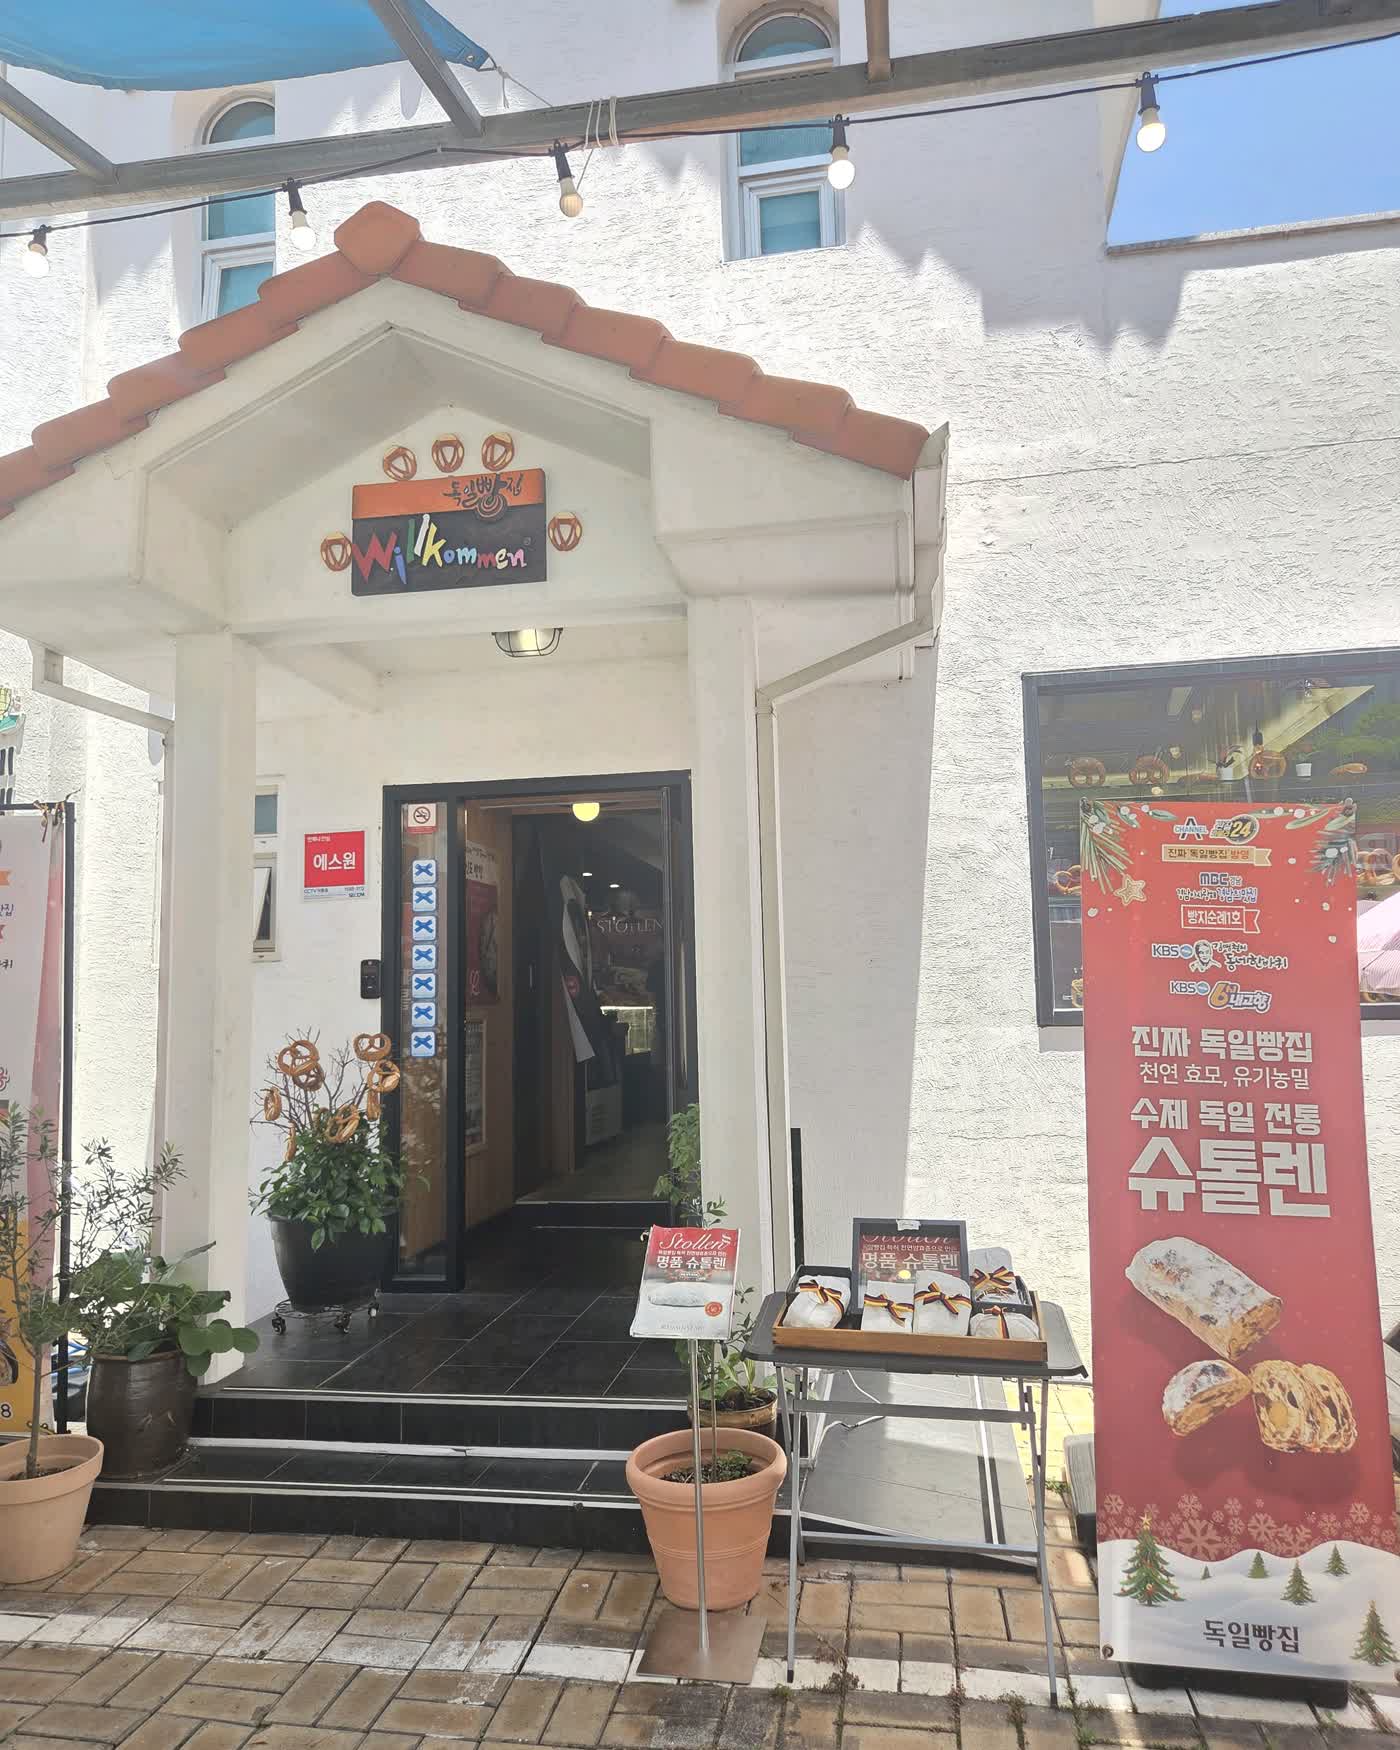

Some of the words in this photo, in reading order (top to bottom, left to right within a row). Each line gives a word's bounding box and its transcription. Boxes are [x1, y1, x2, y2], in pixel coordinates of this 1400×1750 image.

[442, 473, 524, 520] 독일빵집
[351, 513, 527, 585] Willkommen
[1174, 825, 1207, 834] CHANNEL
[1230, 820, 1252, 838] 24
[313, 851, 356, 871] 에스원
[1231, 849, 1250, 860] 방영
[1200, 873, 1228, 886] MBC
[1187, 909, 1242, 926] 빵지순례1호
[1152, 943, 1179, 957] KBS
[1171, 981, 1196, 994] KBS
[1131, 1026, 1191, 1058] 진짜
[1199, 1028, 1313, 1063] 독일빵집
[1139, 1062, 1179, 1085] 천연
[1183, 1064, 1228, 1088] 효모,
[1232, 1066, 1310, 1090] 유기농밀
[1130, 1097, 1188, 1130] 수제
[1199, 1100, 1255, 1134] 독일
[1263, 1102, 1322, 1136] 전통
[1128, 1136, 1332, 1218] 슈톨렌
[659, 1231, 729, 1250] Stollen
[656, 1255, 684, 1269] 명품
[686, 1256, 727, 1271] 슈톨렌
[861, 1252, 897, 1270] 명품
[902, 1253, 959, 1271] 슈톨렌
[1203, 1619, 1300, 1654] 독일빵집
